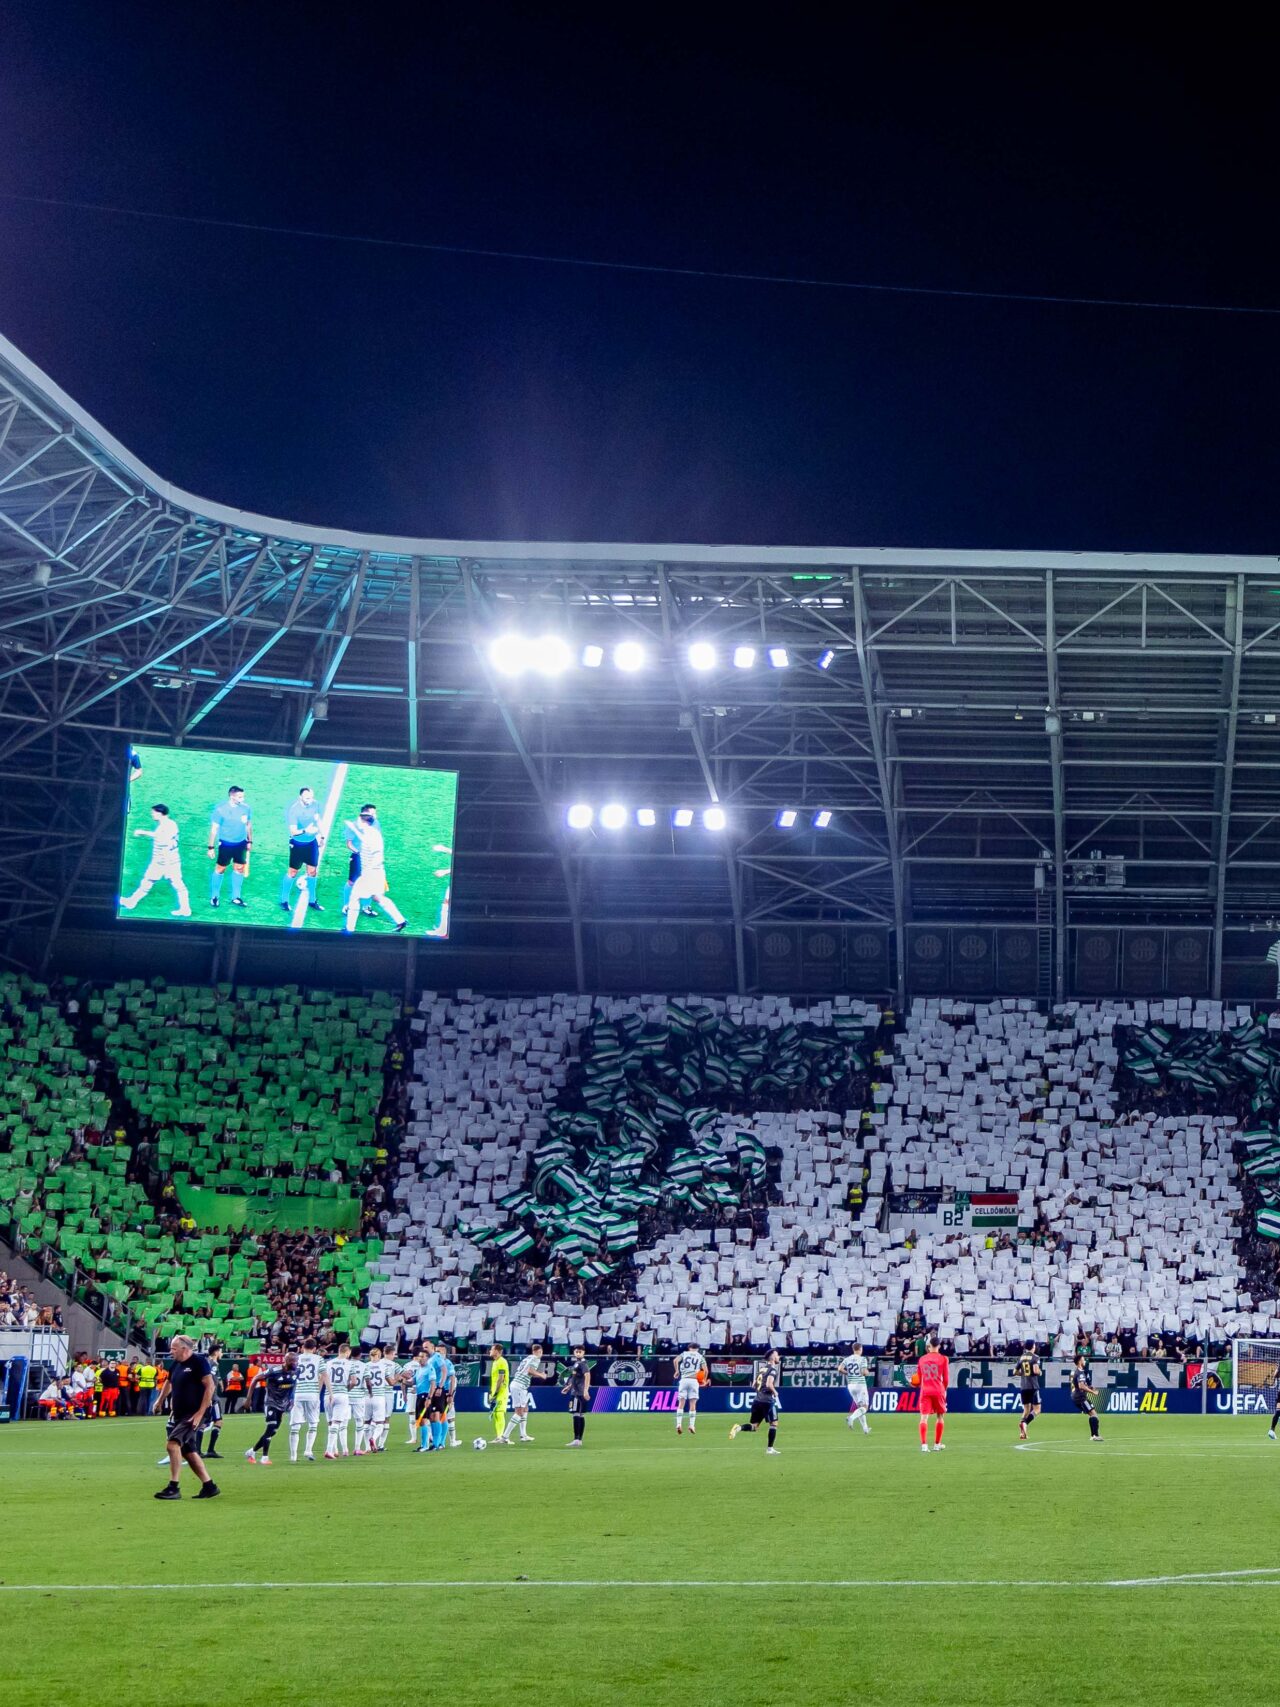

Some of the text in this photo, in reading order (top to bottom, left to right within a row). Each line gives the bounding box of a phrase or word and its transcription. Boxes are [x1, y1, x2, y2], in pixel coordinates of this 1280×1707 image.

[944, 1211, 964, 1226] B2
[684, 1357, 699, 1369] 64
[848, 1363, 860, 1375] 22
[298, 1363, 316, 1381] 23
[331, 1367, 345, 1383] 19
[617, 1391, 649, 1411] OME
[974, 1393, 1025, 1410] UEFA
[1107, 1392, 1168, 1411] OME ALL
[1217, 1394, 1268, 1411] UEFA
